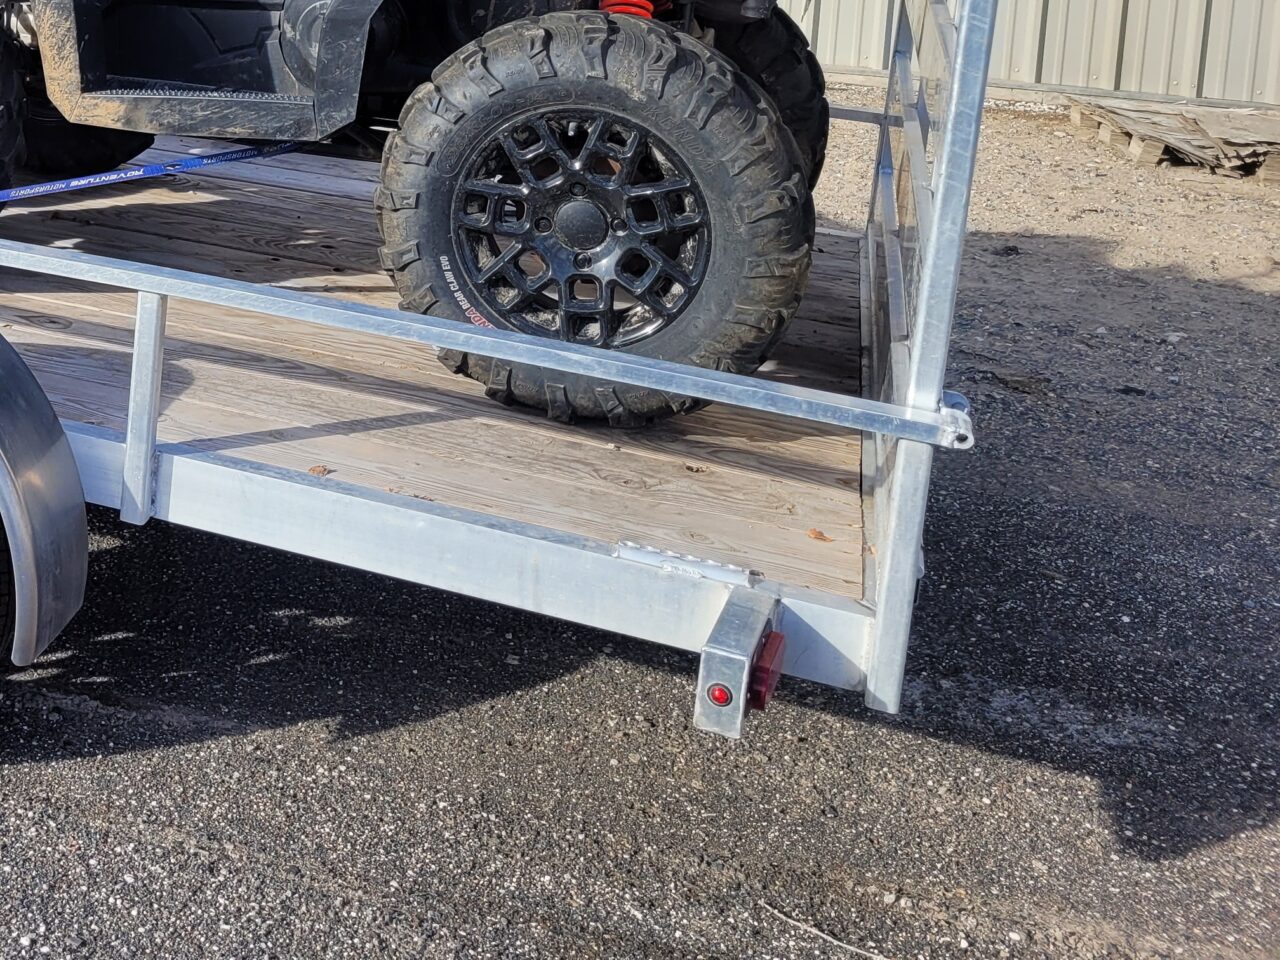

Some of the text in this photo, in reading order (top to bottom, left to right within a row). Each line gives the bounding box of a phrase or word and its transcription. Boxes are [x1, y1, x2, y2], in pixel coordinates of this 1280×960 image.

[69, 167, 145, 187] ADVENTURE
[439, 255, 499, 330] NDA BEAR CLAW EVO
